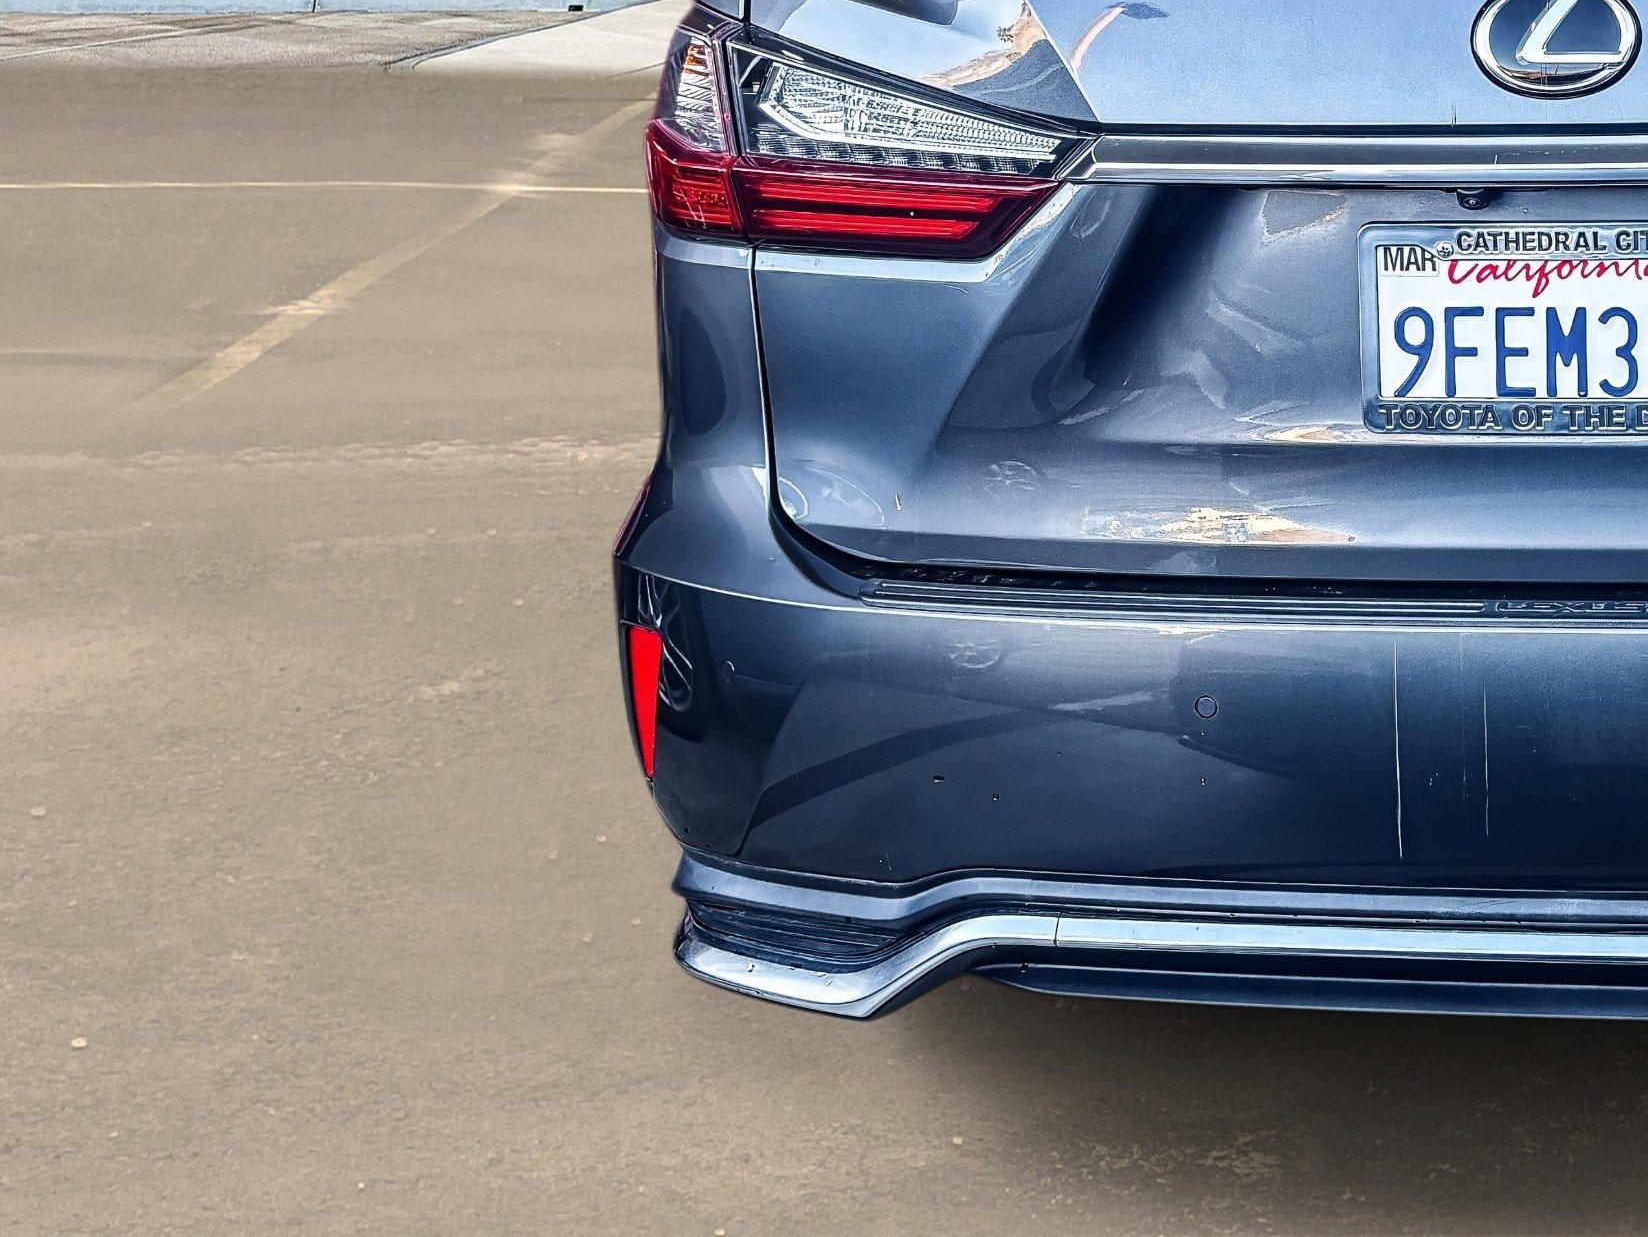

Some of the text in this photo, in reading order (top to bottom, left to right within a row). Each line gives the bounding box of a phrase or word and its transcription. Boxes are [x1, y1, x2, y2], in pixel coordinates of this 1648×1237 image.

[1456, 231, 1607, 254] CATHEDRAL
[1383, 247, 1437, 272] MAR
[1379, 403, 1503, 430] TOYOTA
[1511, 403, 1552, 429] OF
[1563, 403, 1627, 430] THE
